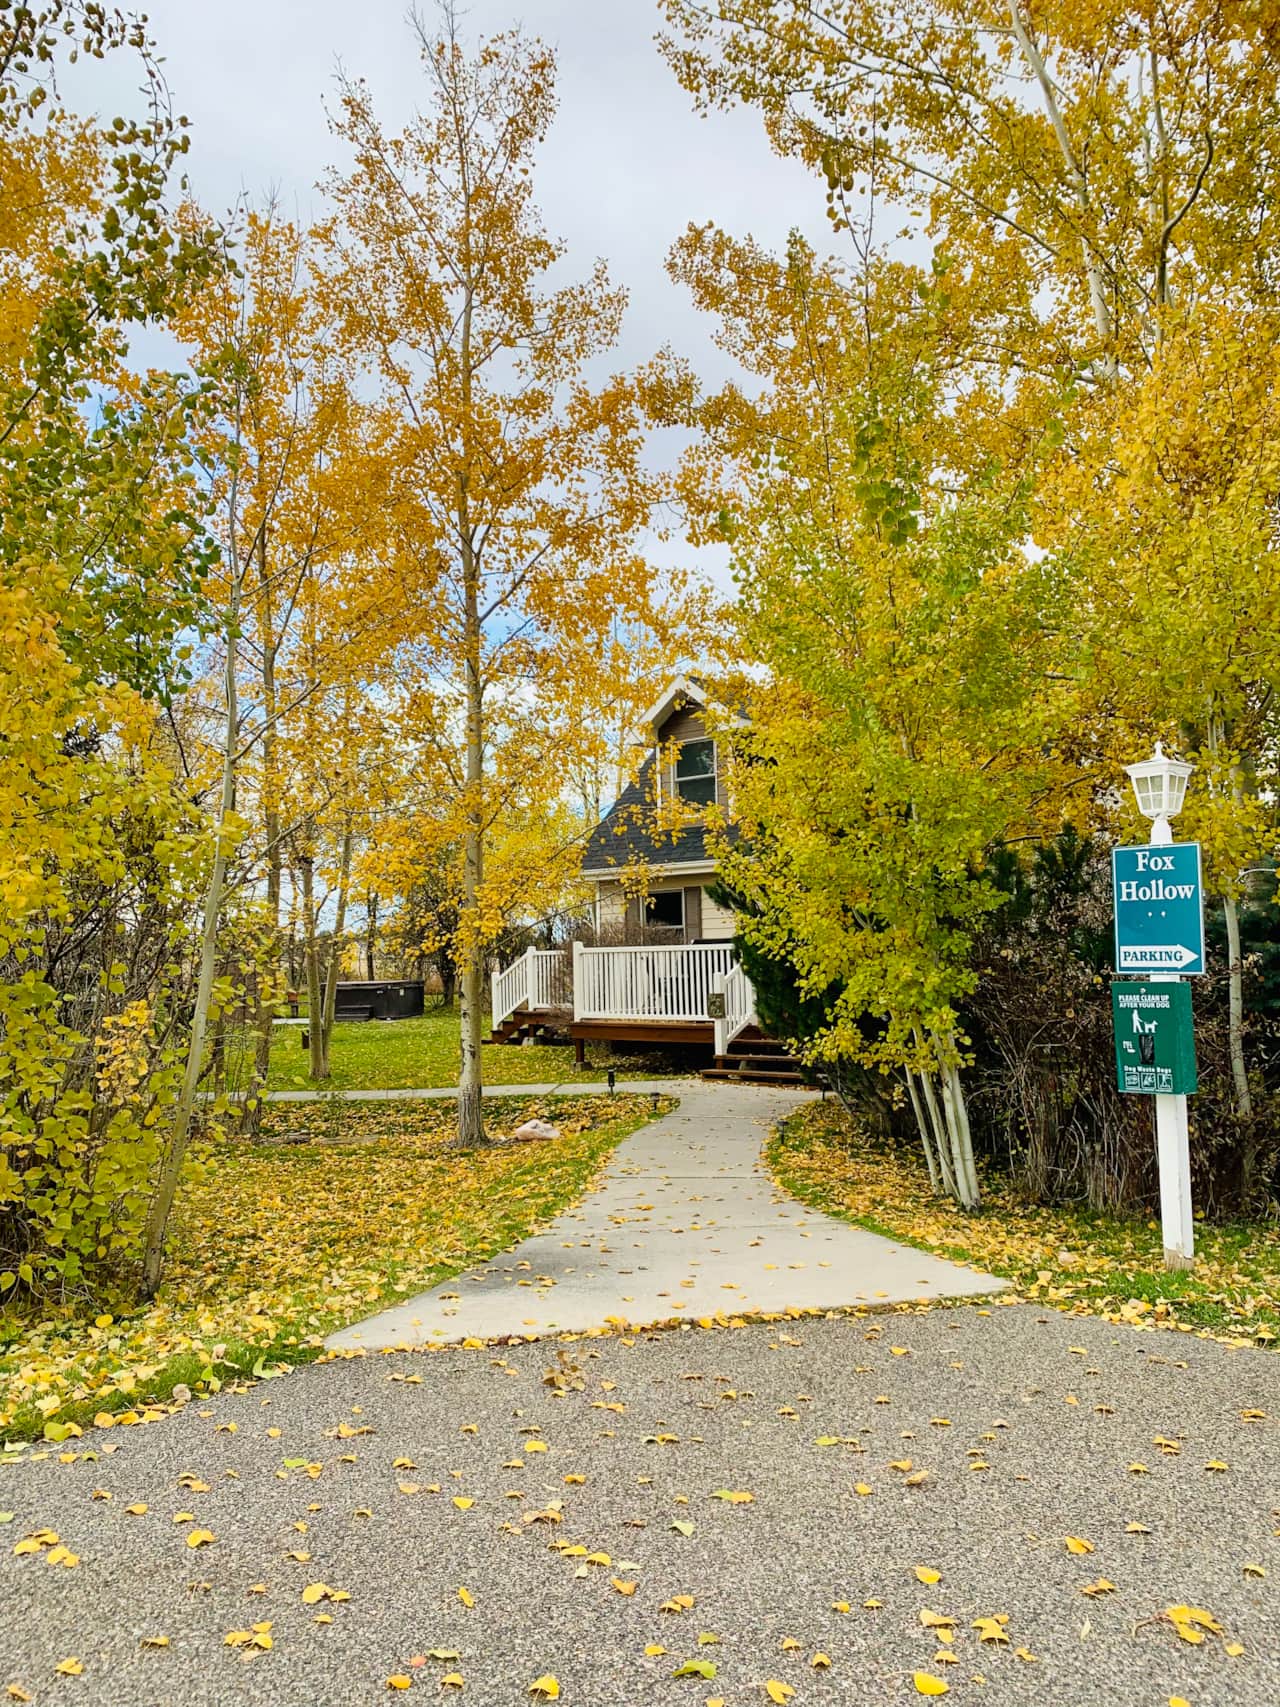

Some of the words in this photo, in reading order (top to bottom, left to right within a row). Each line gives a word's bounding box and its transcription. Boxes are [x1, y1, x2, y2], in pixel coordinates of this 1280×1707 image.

[1136, 851, 1175, 871] Fox
[1120, 879, 1195, 901] Hollow
[1123, 951, 1183, 961] PARKING
